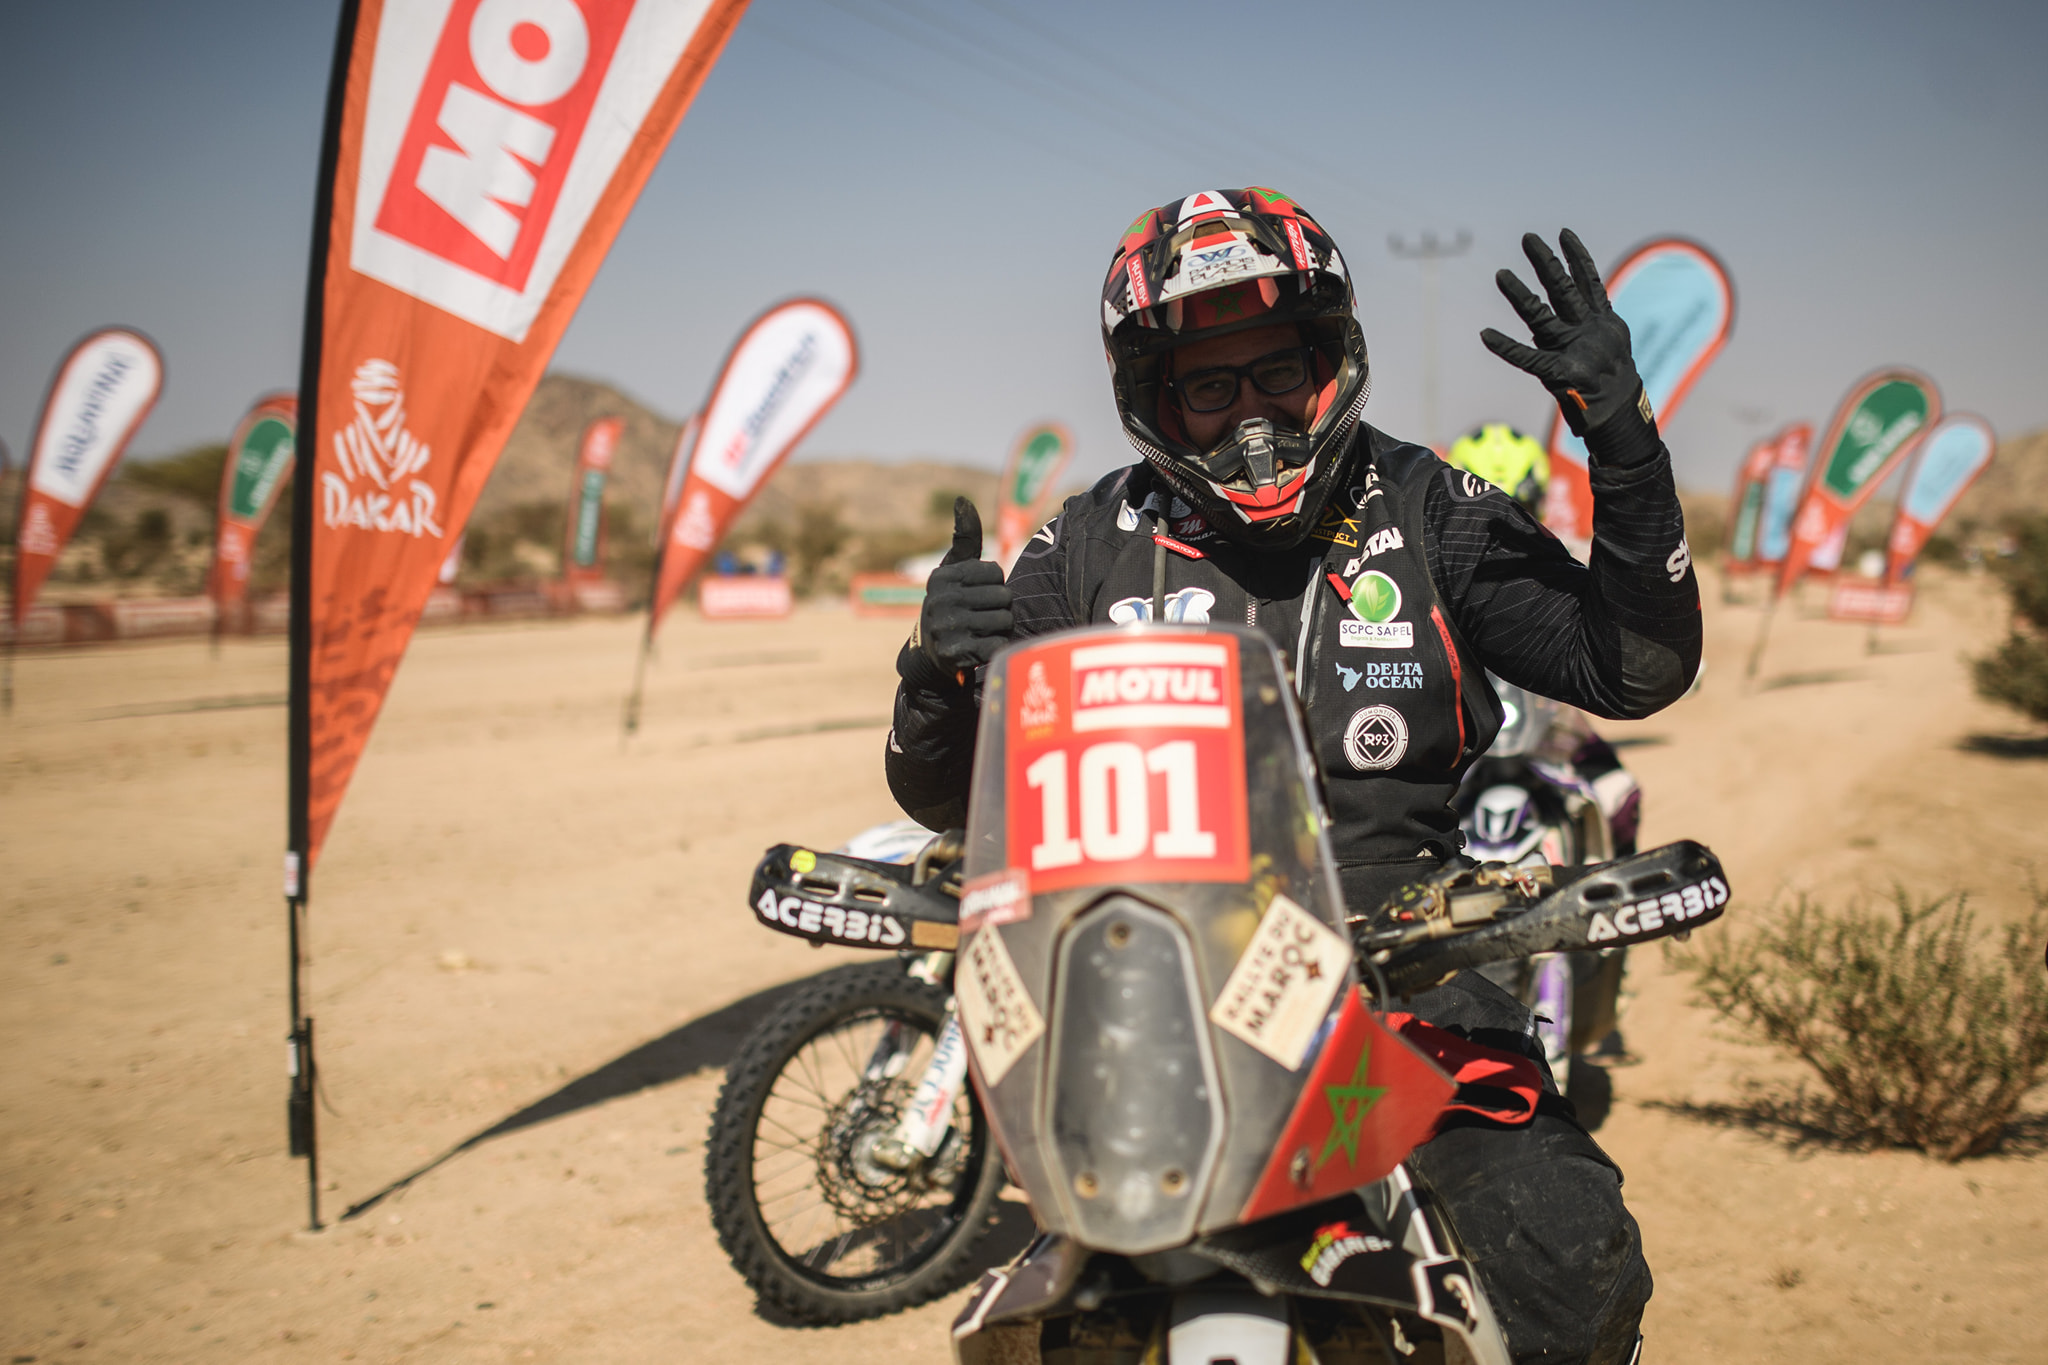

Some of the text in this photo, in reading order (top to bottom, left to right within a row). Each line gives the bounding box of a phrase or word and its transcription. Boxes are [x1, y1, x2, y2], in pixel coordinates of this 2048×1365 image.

[322, 471, 444, 538] DAKAR
[1157, 538, 1195, 556] HYDRATION
[1342, 624, 1412, 636] SCPC SAPEL
[1081, 667, 1219, 705] MOTUL
[1365, 676, 1423, 689] OCEAN
[1366, 662, 1424, 676] DELTA
[1026, 741, 1216, 870] 101
[757, 888, 905, 945] ACERBIS
[1588, 876, 1730, 943] ACERBIS
[1245, 921, 1317, 1037] MAROC
